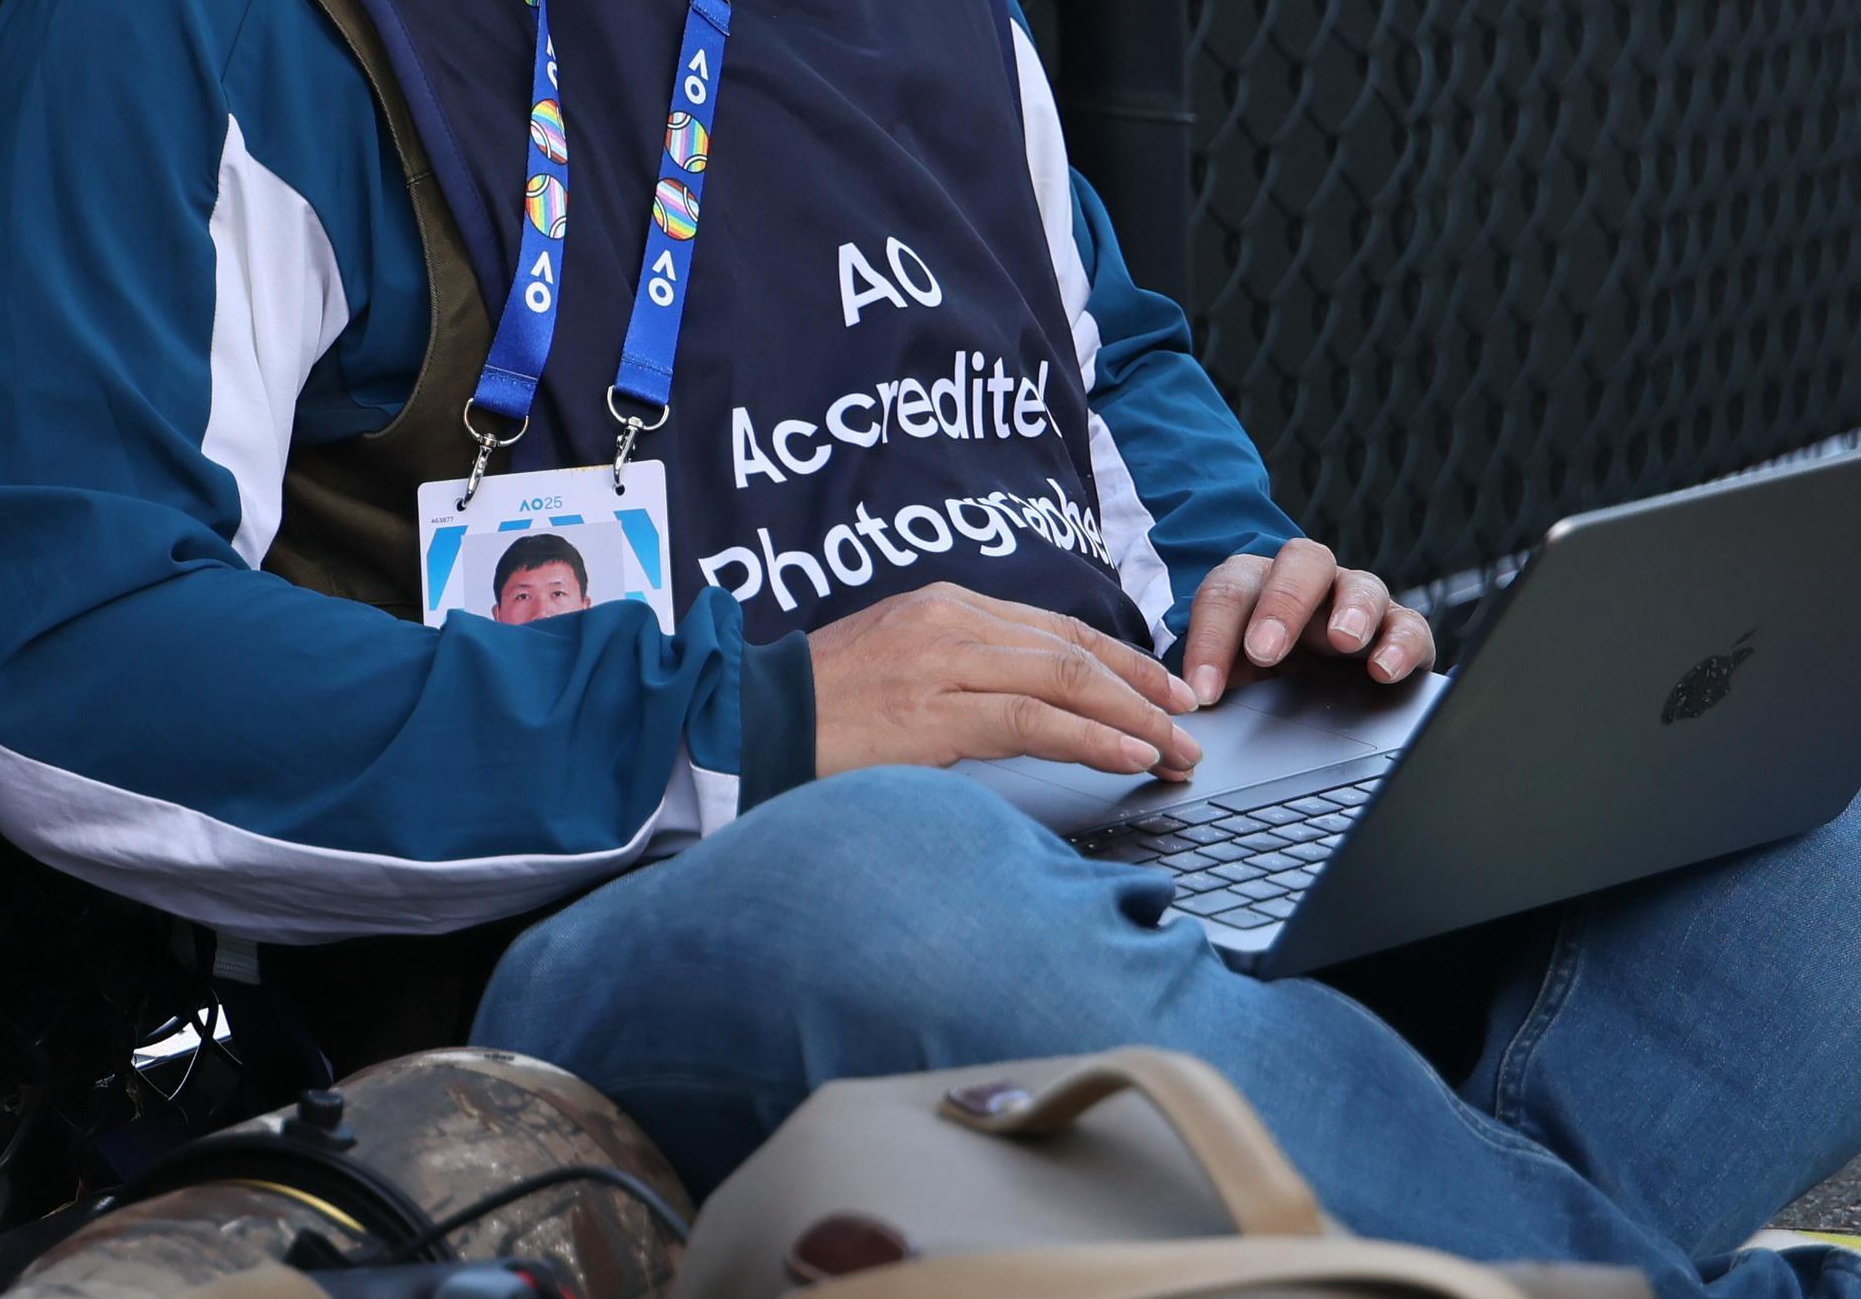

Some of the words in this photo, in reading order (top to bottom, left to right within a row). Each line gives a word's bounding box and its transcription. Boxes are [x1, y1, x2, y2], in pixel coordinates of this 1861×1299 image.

[687, 48, 709, 105] AO
[524, 250, 554, 313] AO
[647, 249, 677, 307] AO
[836, 236, 942, 327] AO
[519, 496, 563, 512] AO25
